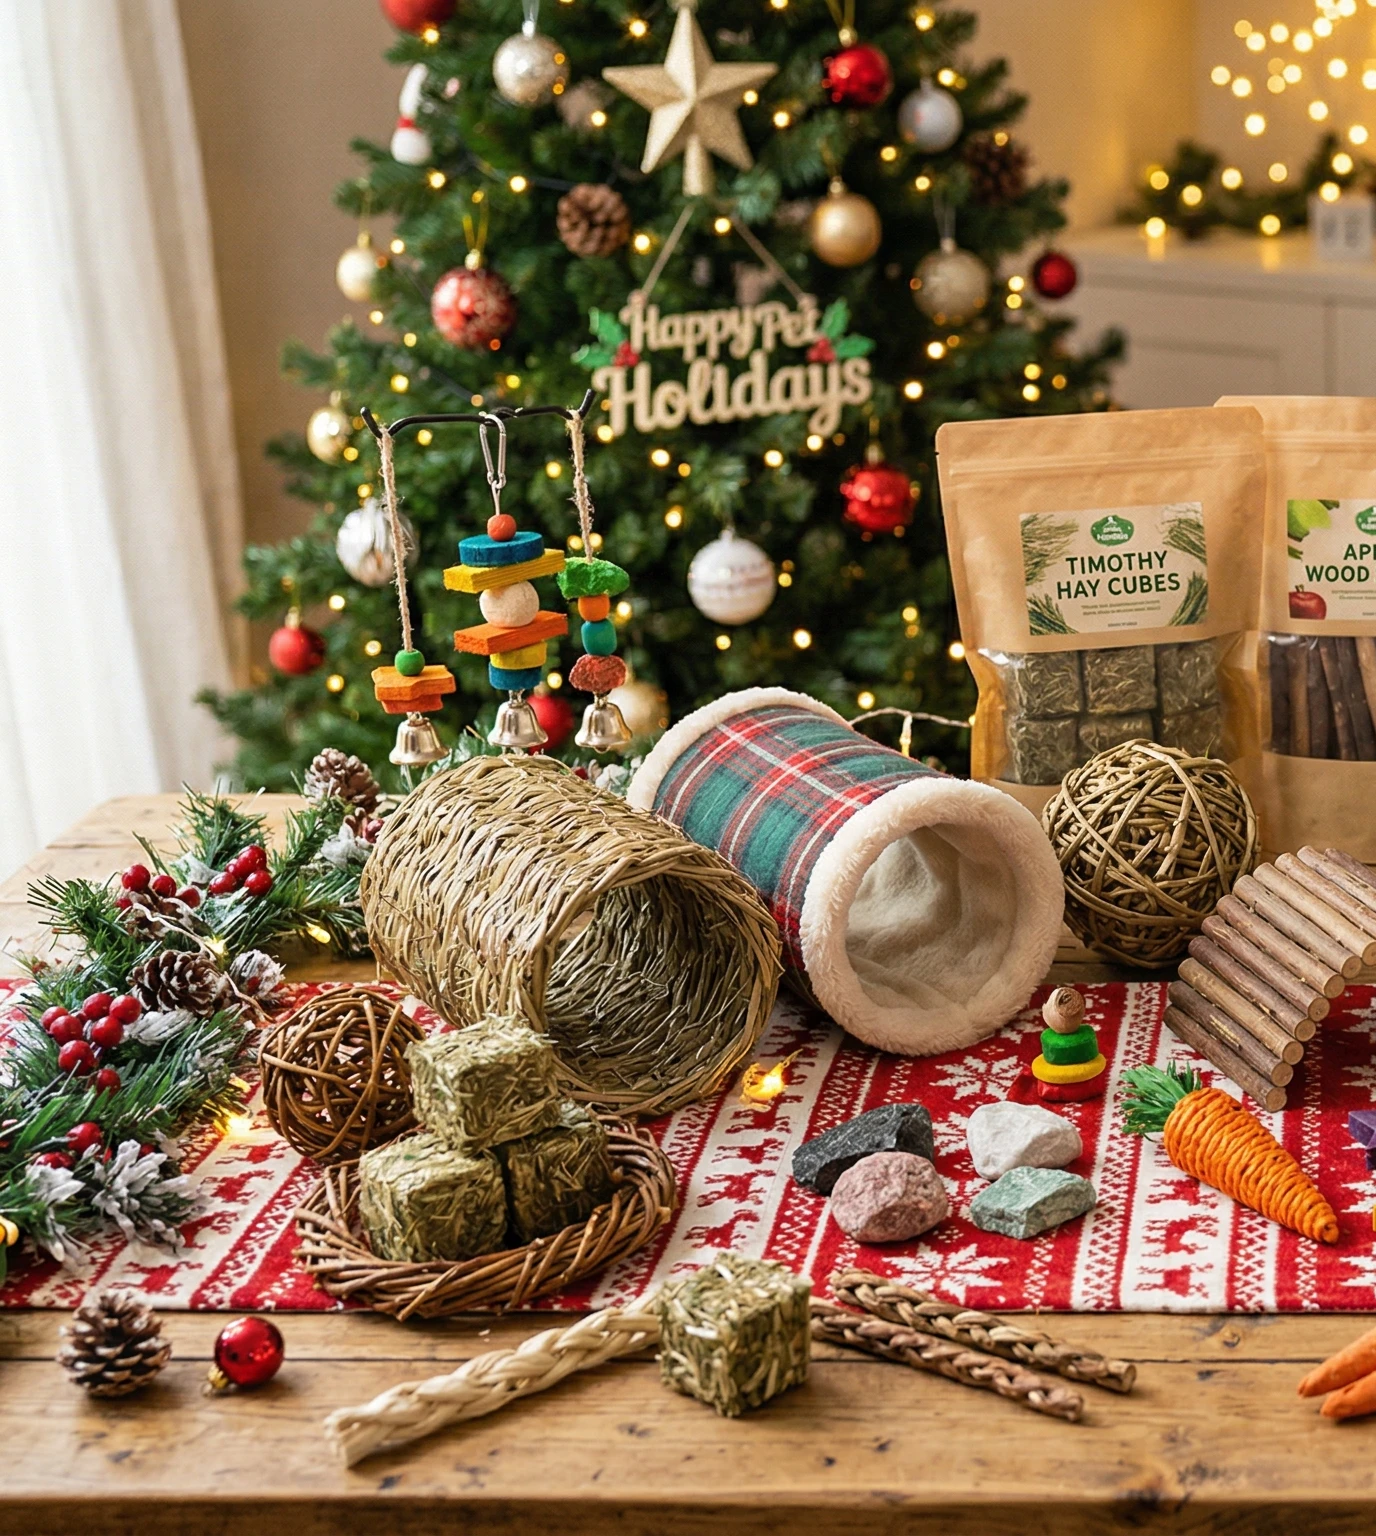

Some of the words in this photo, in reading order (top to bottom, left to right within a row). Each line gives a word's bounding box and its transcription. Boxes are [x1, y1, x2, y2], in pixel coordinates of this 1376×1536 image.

[619, 293, 756, 361] Happy
[756, 297, 821, 352] Pet
[591, 350, 873, 438] Holidays
[1065, 550, 1168, 575] TIMOTHY
[1305, 565, 1370, 583] WOOD
[1056, 579, 1101, 600] HAY
[1107, 573, 1181, 596] CUBES
